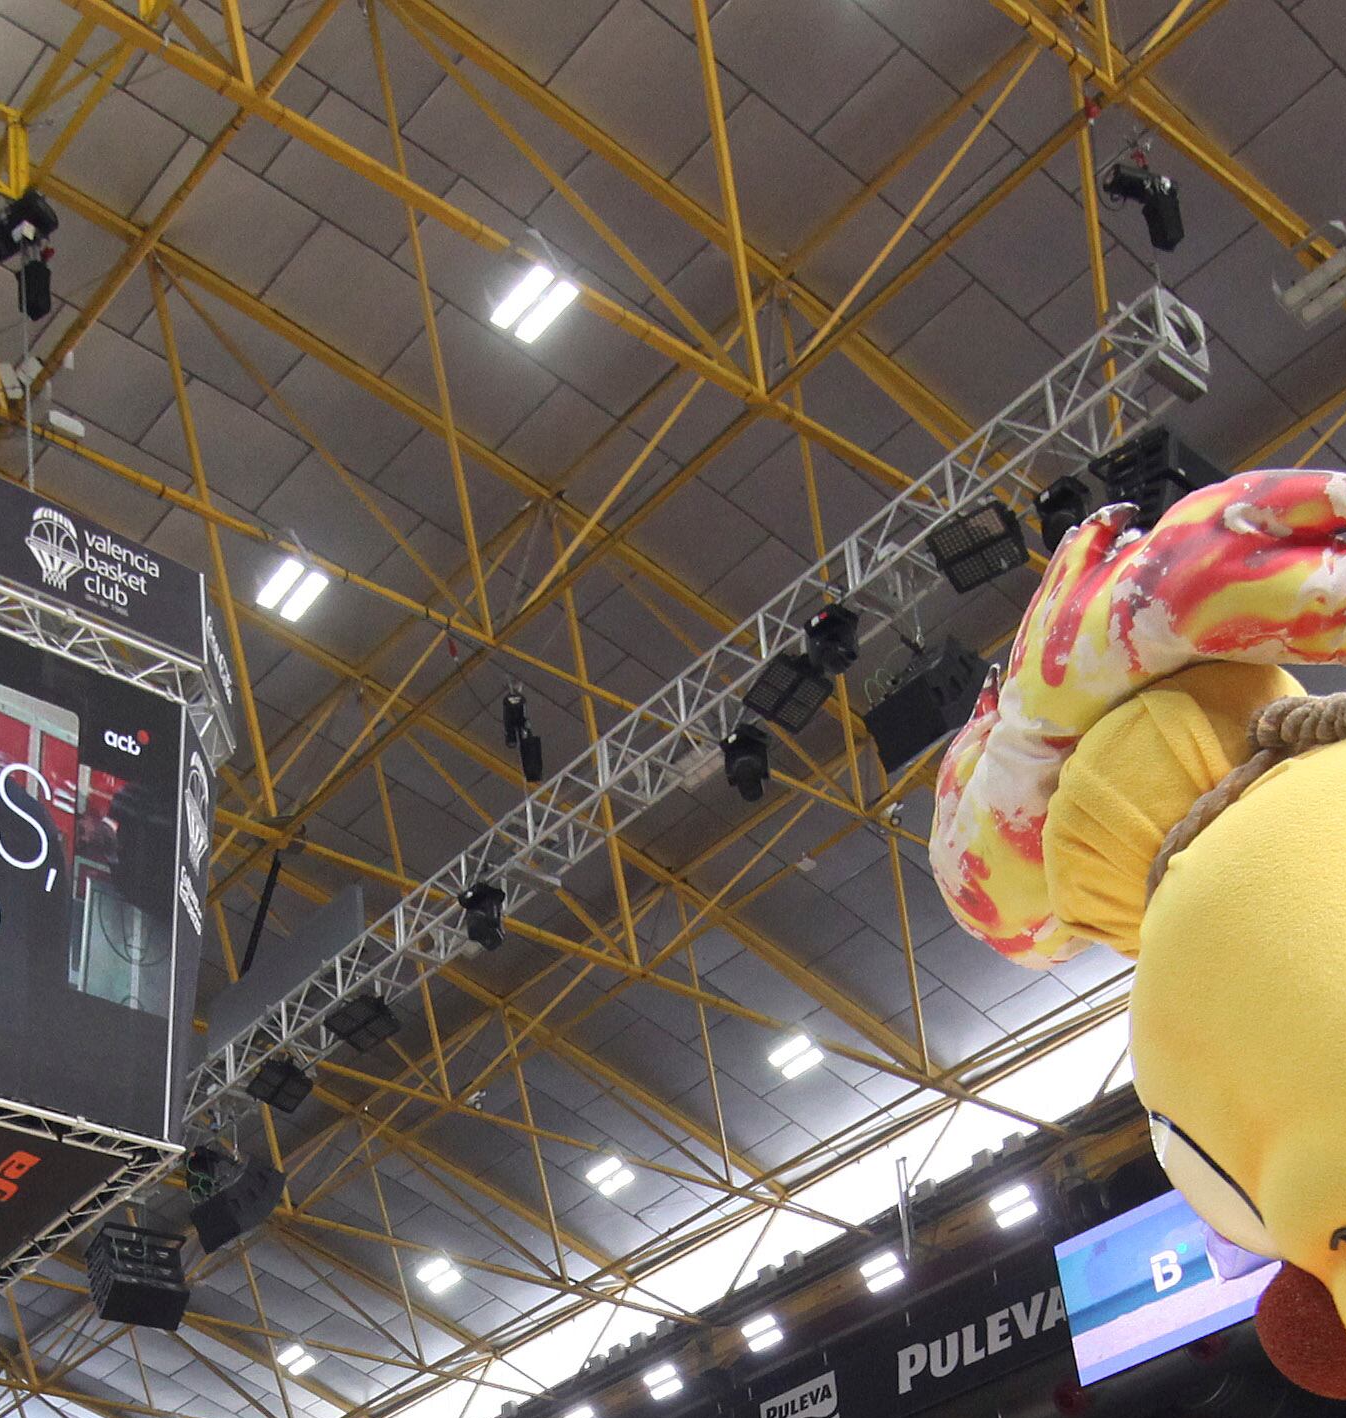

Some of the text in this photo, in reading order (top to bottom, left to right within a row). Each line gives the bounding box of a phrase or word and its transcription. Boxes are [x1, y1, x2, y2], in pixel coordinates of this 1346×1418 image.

[84, 530, 160, 578] valencia
[84, 548, 147, 595] basket
[84, 575, 128, 606] club
[104, 728, 141, 756] acb
[1151, 1249, 1183, 1293] B
[897, 1286, 1067, 1394] PULEVA
